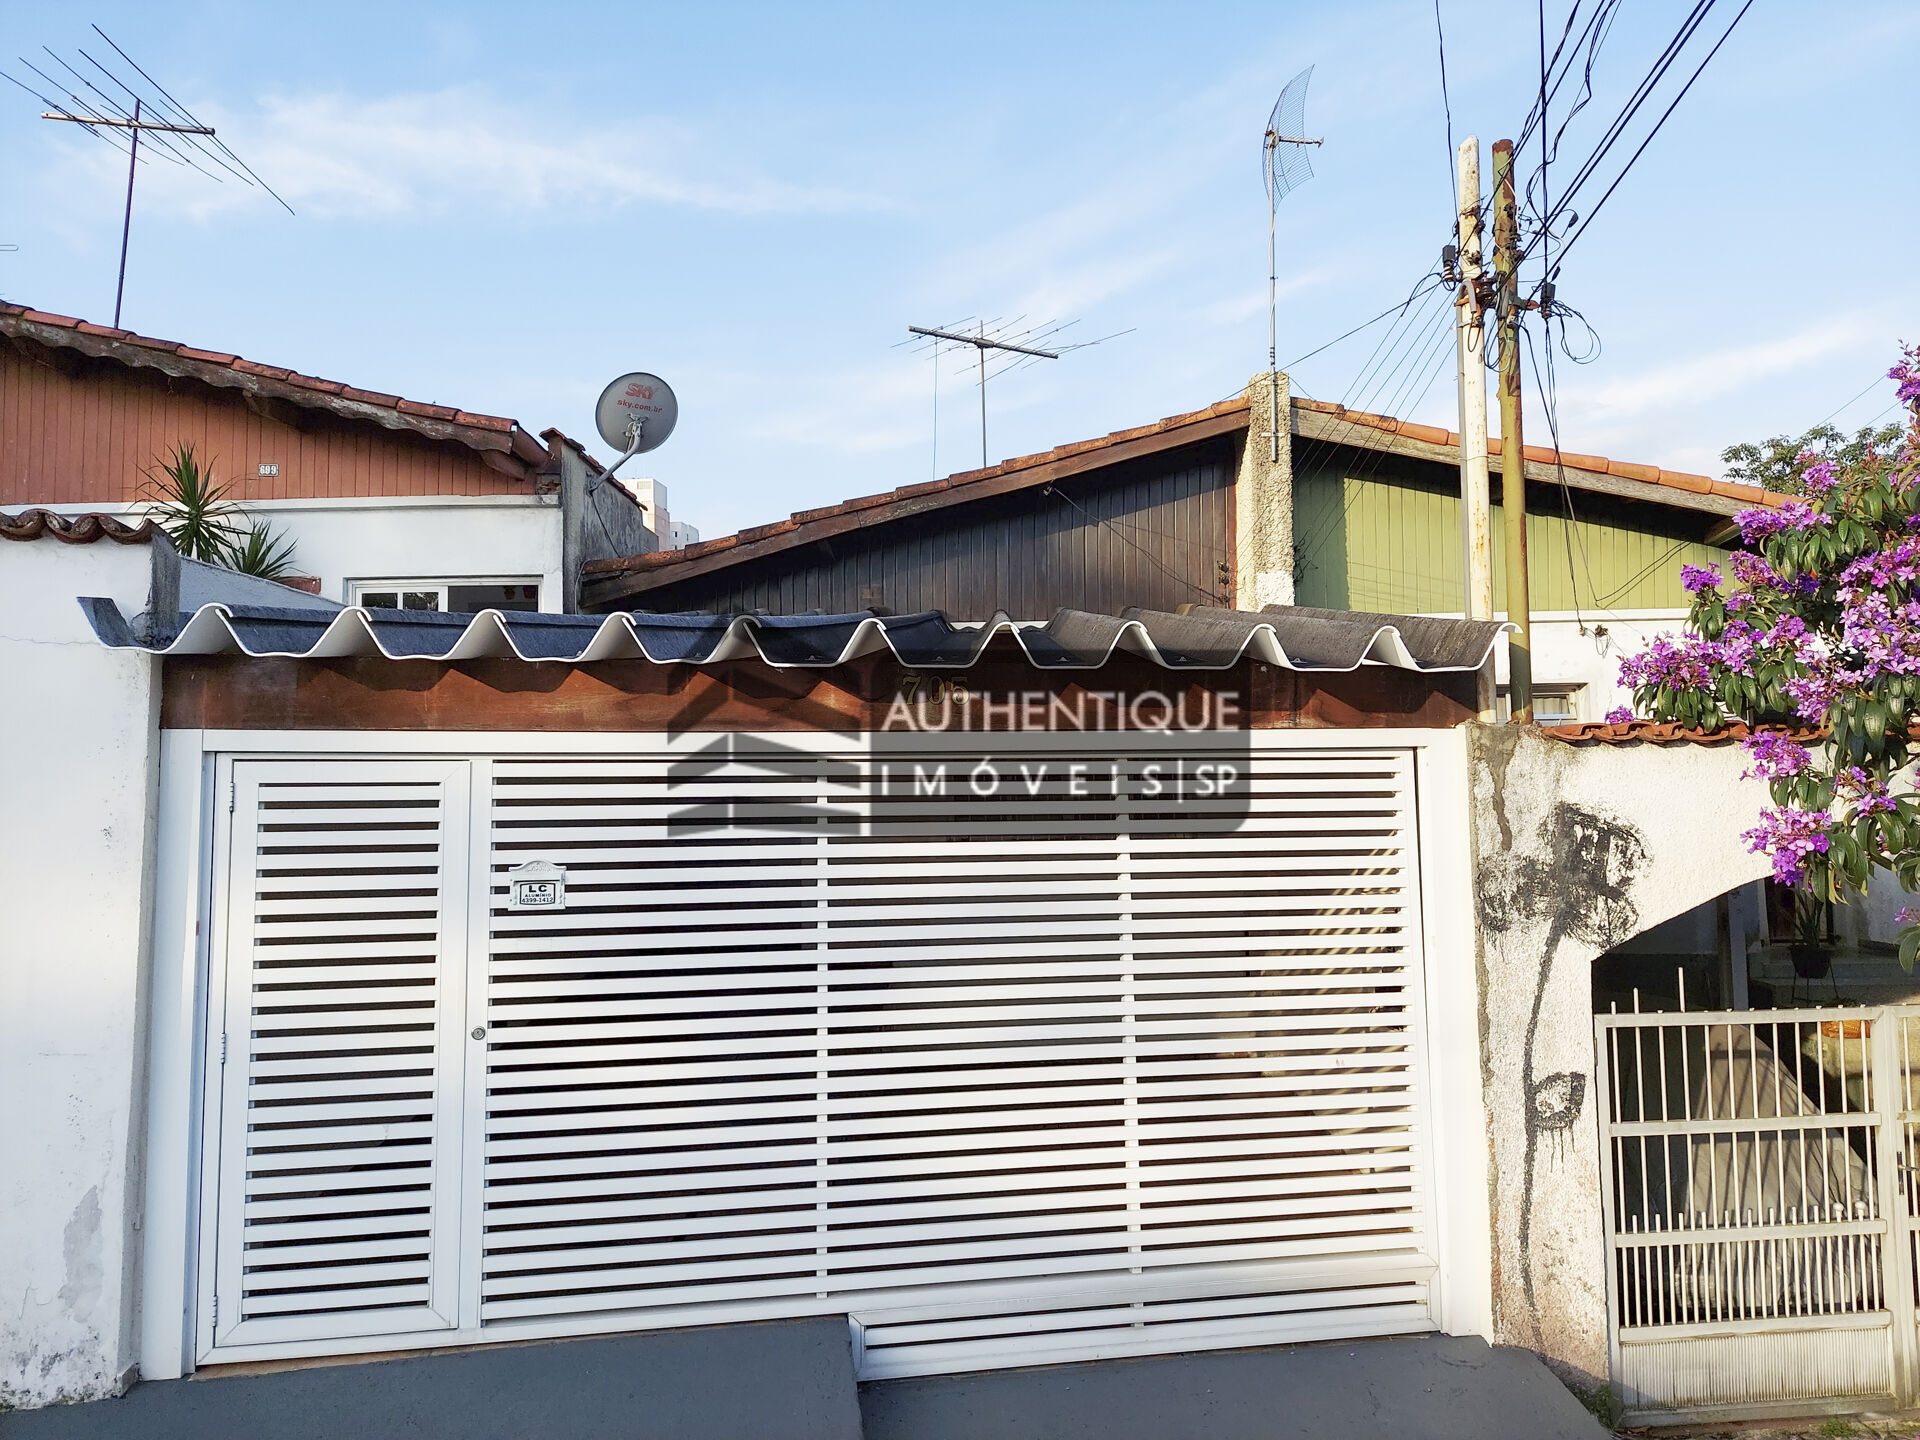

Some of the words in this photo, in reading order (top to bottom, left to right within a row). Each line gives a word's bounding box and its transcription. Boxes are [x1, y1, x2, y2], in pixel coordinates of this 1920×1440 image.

[625, 382, 654, 400] SKY
[617, 398, 663, 413] sky.com.br
[260, 465, 277, 475] 699
[903, 675, 970, 705] 705
